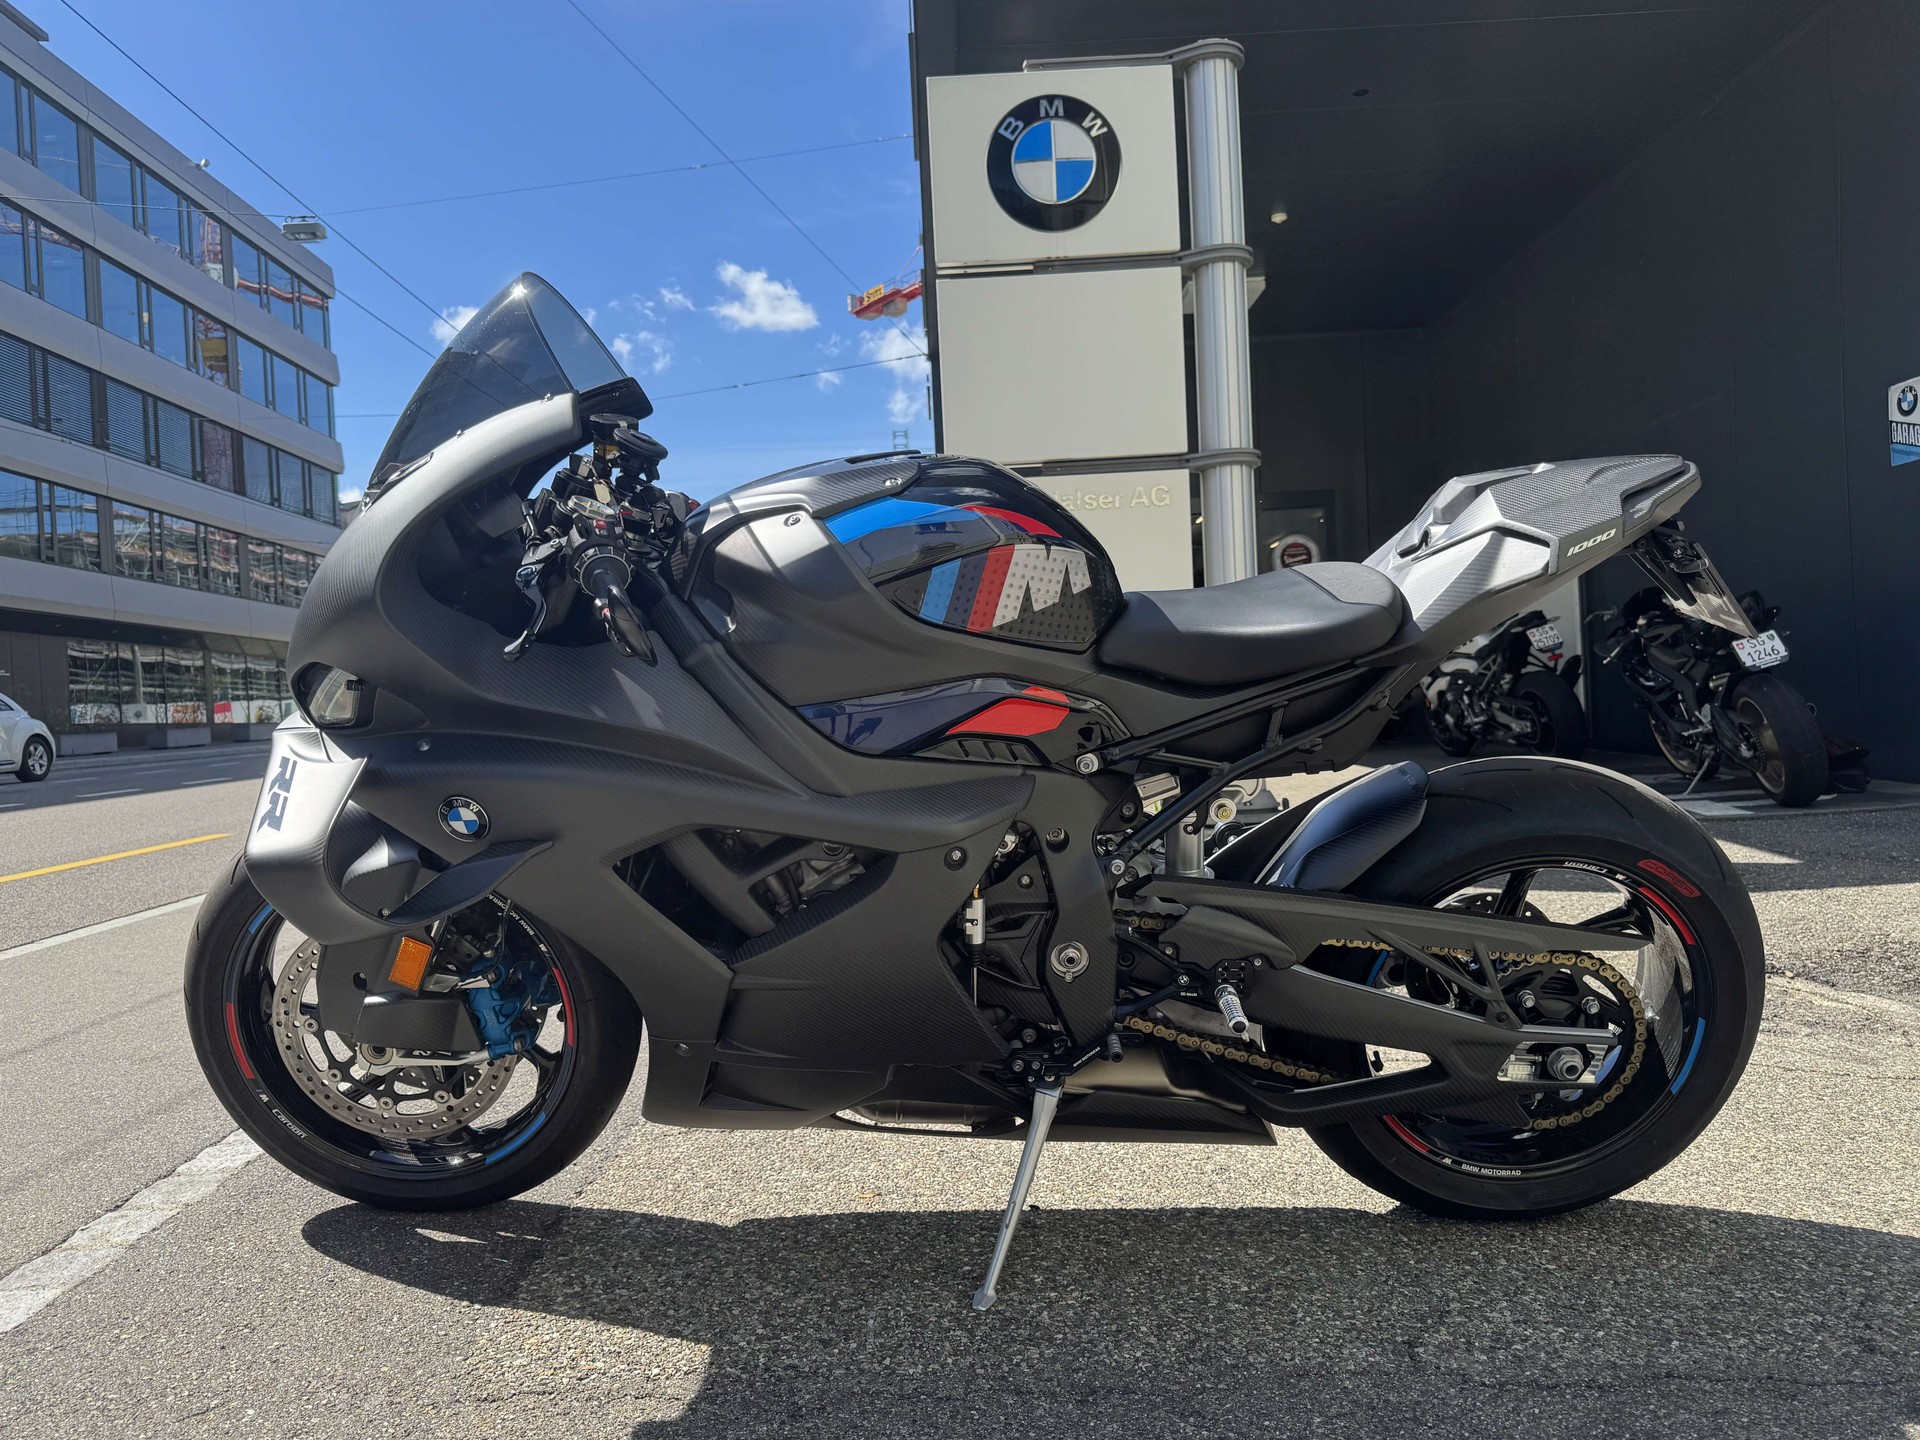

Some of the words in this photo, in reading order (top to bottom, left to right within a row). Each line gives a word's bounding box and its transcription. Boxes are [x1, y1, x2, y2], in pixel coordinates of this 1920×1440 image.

[998, 97, 1109, 142] BMW
[1129, 484, 1171, 508] AG
[1566, 528, 1617, 557] 1000
[1533, 633, 1561, 648] 25709
[1535, 626, 1549, 637] SG
[1746, 636, 1766, 649] SG
[1747, 644, 1780, 663] 1246
[257, 755, 298, 833] RR
[441, 799, 480, 815] BMW
[1644, 860, 1695, 895] CORSA
[1461, 1163, 1480, 1173] BMW
[1480, 1167, 1522, 1176] MOTORRAD
